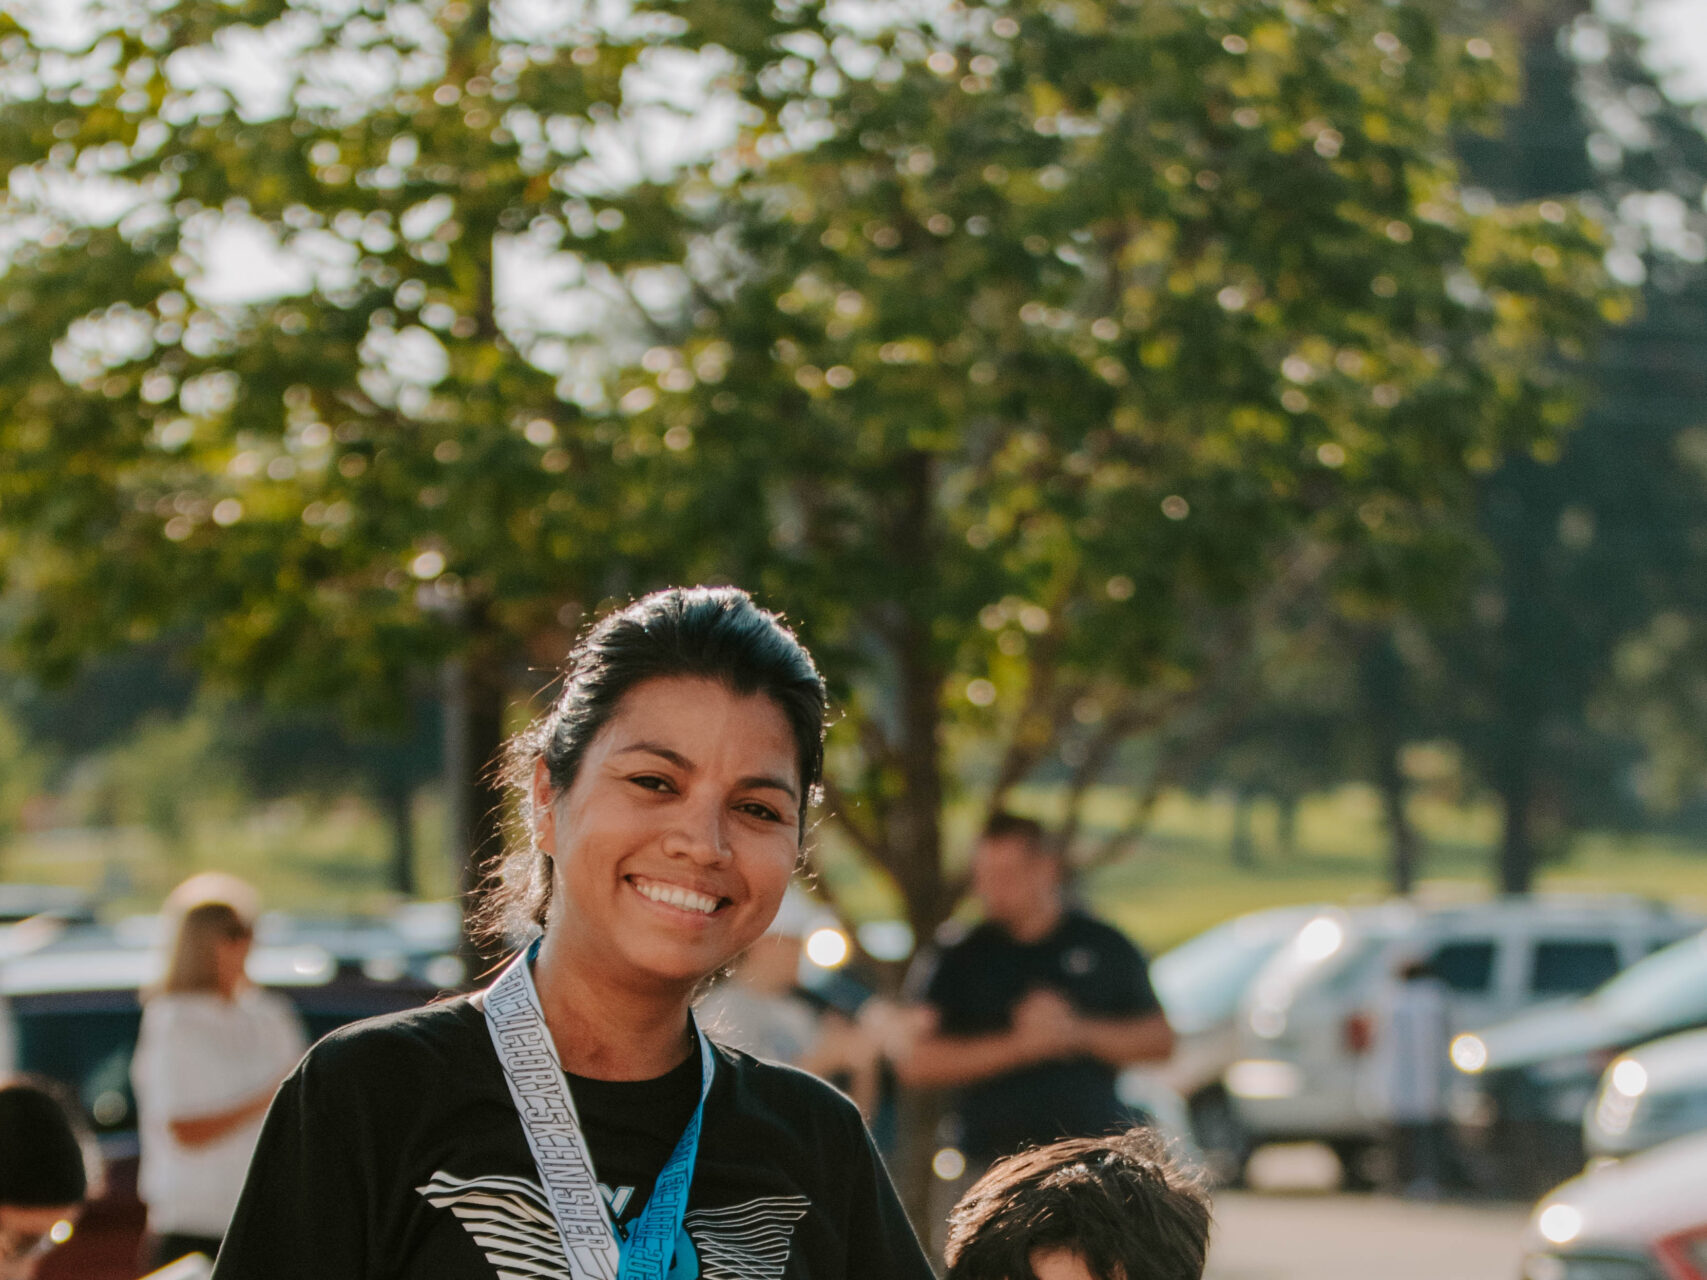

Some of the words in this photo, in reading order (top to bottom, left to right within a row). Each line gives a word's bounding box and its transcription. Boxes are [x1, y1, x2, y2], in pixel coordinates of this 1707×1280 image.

[494, 1004, 564, 1100] VICTORY
[524, 1105, 577, 1143] 5K
[537, 1145, 610, 1251] FINISHER
